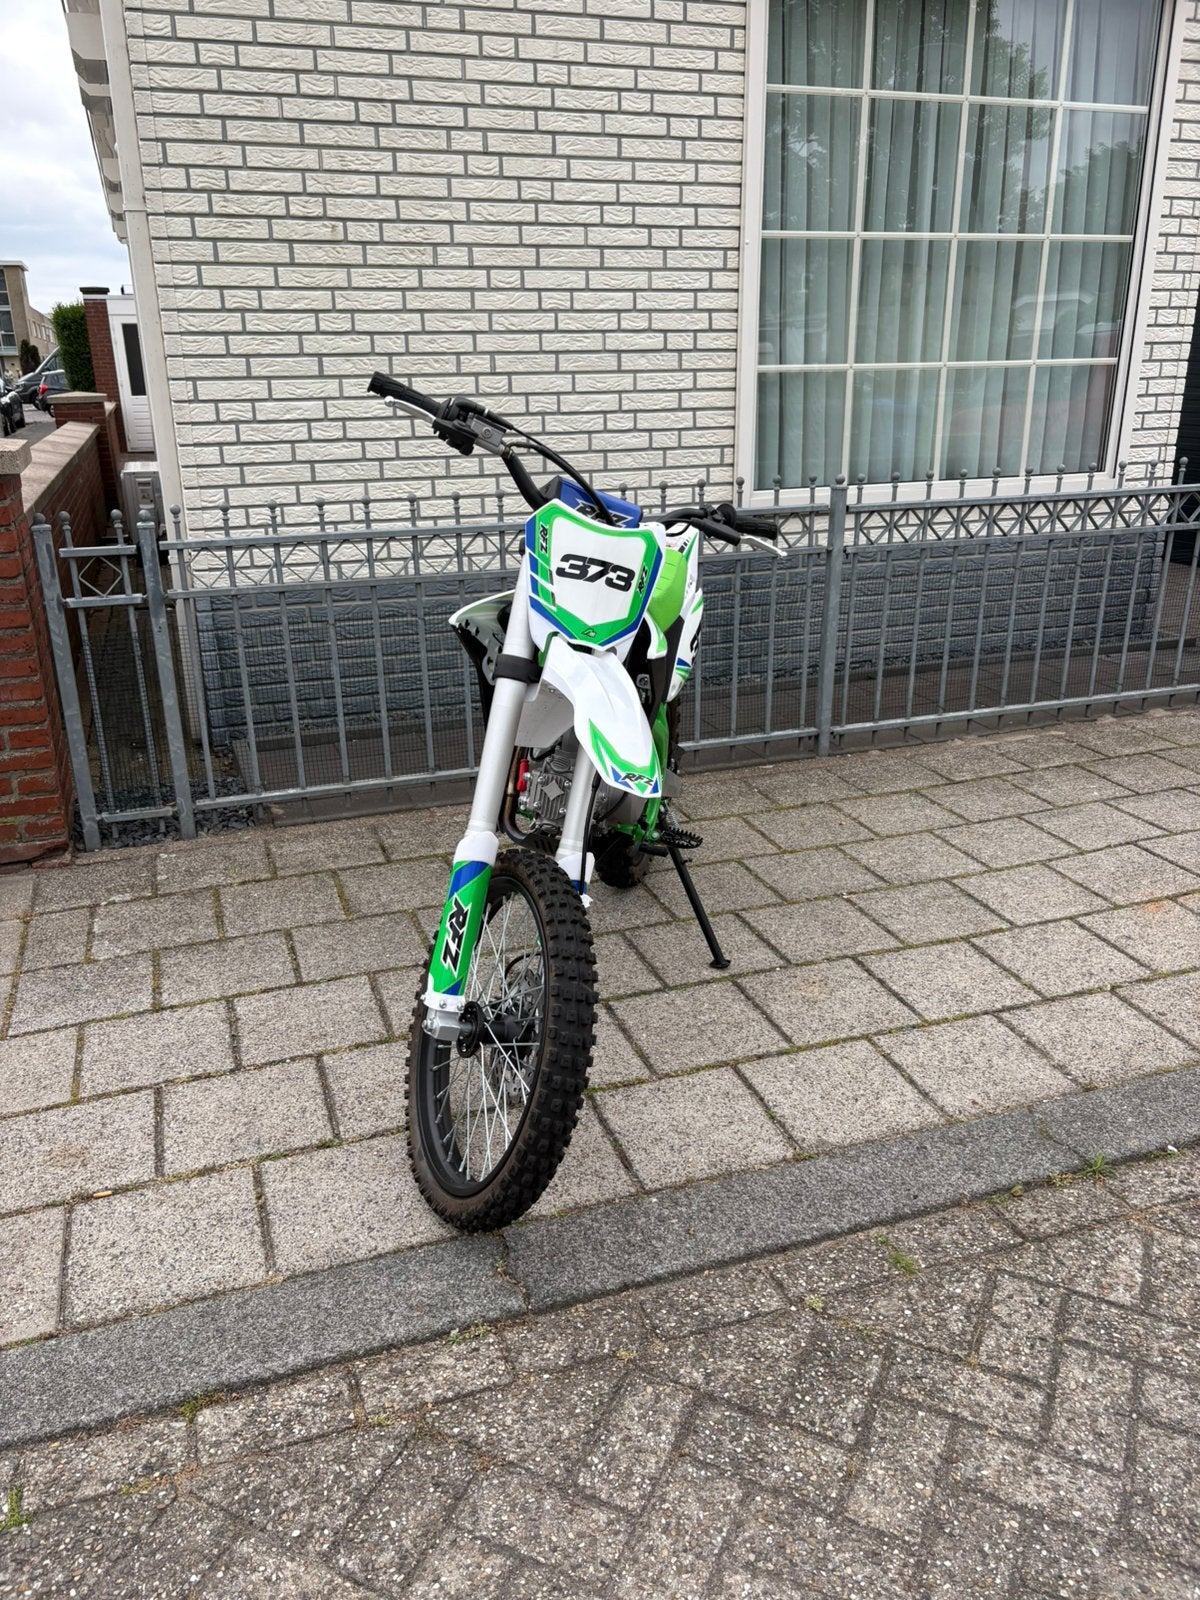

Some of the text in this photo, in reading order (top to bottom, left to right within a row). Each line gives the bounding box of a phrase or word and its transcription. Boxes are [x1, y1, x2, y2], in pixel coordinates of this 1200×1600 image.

[539, 522, 549, 554] RFZ
[555, 553, 636, 592] 373
[621, 772, 655, 786] RFZ
[442, 893, 472, 977] RFZ
